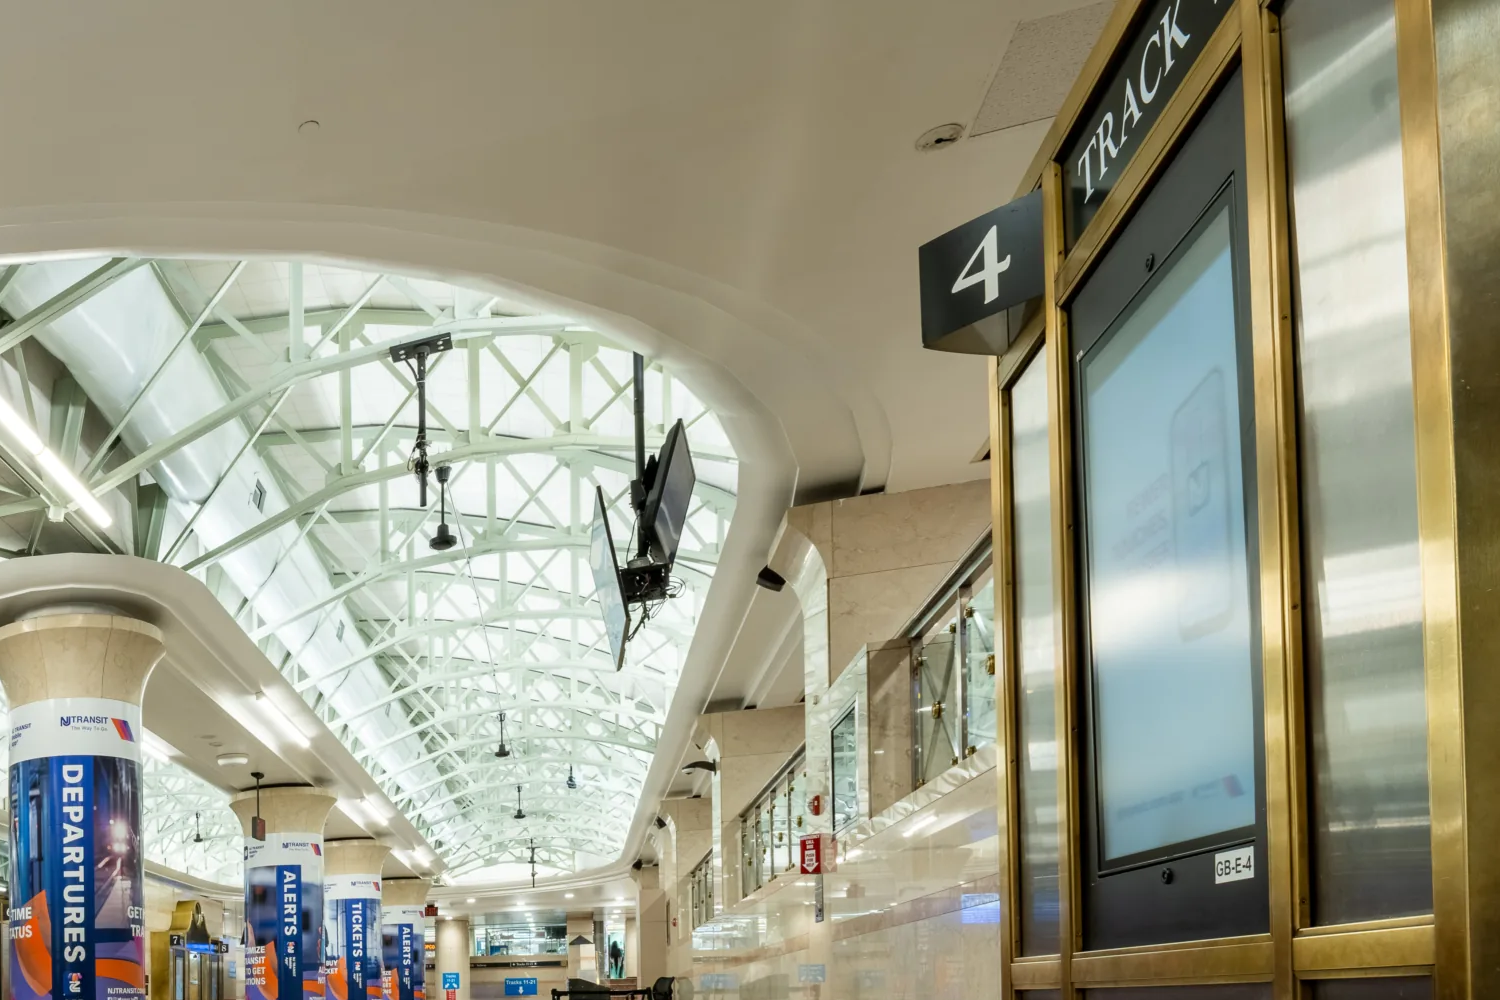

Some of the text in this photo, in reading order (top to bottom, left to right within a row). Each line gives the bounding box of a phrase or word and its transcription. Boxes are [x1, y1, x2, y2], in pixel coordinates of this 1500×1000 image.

[1077, 0, 1191, 204] TRACK
[951, 223, 1011, 305] 4
[62, 765, 86, 963] DEPARTURES
[1216, 855, 1252, 877] GB-E-4
[284, 870, 297, 936] ALERTS
[173, 936, 178, 945] 7
[221, 944, 227, 952] 8
[351, 902, 363, 957] TICKETS
[402, 927, 411, 965] ALERTS
[252, 966, 266, 975] GET
